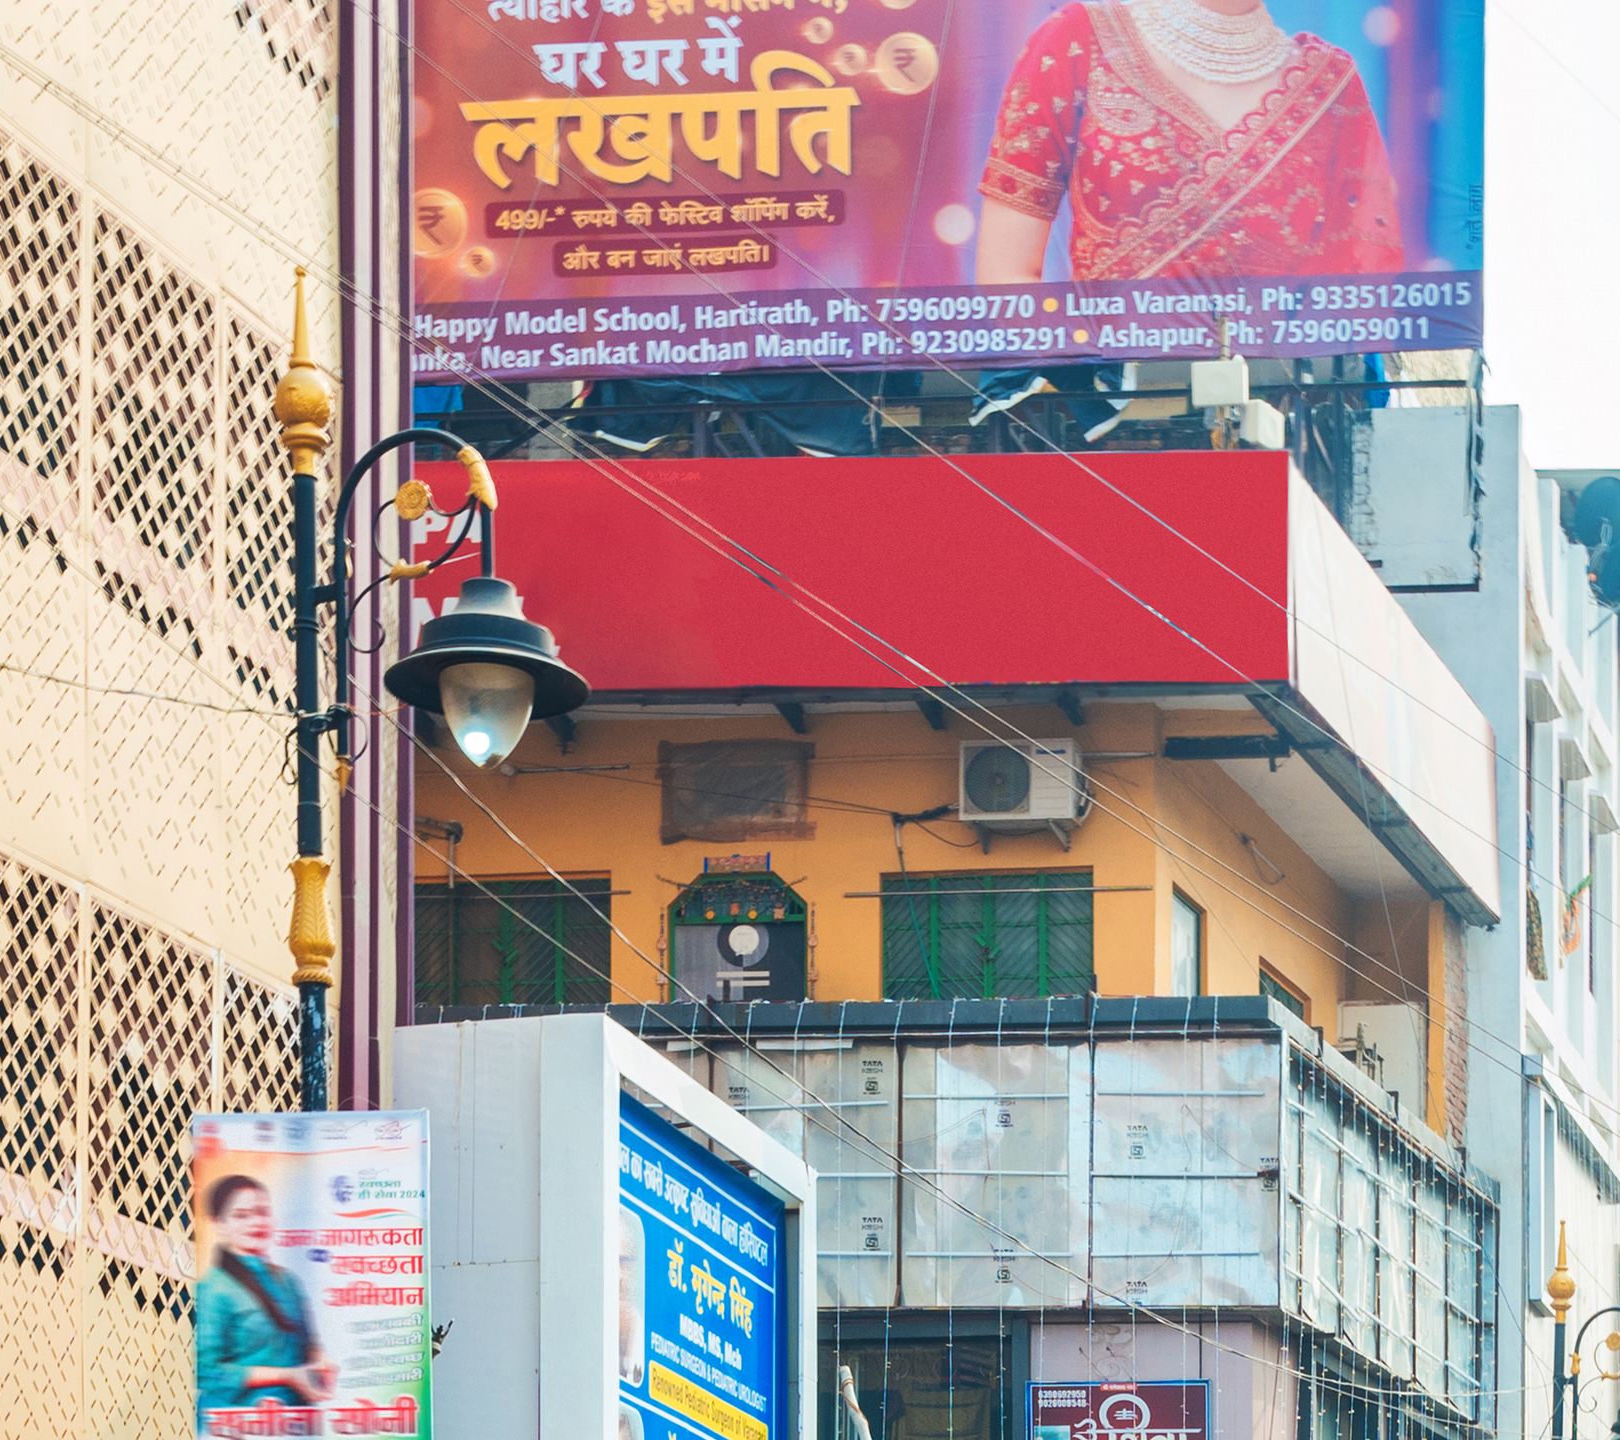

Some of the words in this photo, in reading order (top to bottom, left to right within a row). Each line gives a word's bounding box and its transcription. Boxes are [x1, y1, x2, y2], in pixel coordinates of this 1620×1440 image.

[533, 39, 606, 88] घर
[615, 39, 689, 86] घर
[696, 16, 743, 83] में
[460, 50, 861, 190] लखपति
[571, 202, 617, 229] रुपये
[625, 200, 652, 228] की
[659, 200, 723, 226] फेस्टिव
[730, 194, 789, 224] शॉपिंग
[562, 244, 598, 271] और
[606, 252, 636, 270] बन
[414, 312, 496, 342] Happy
[505, 308, 587, 335] Model
[594, 304, 687, 334] School,
[827, 297, 869, 323] Ph:
[876, 294, 1035, 322] 7596099770
[1065, 291, 1126, 318] Luxa
[1132, 288, 1253, 316] Varanasi,
[1261, 286, 1303, 311] Ph:
[1311, 281, 1472, 309] 9335126015
[483, 346, 542, 370] Near
[549, 343, 639, 367] Sankat
[646, 338, 746, 365] Mochan
[755, 332, 852, 360] Mandir,
[862, 330, 903, 355] Ph:
[911, 326, 1067, 355] 9230985291
[1098, 322, 1215, 350] Ashapur,
[1224, 320, 1264, 346] Ph:
[1271, 317, 1430, 345] 7596059011
[400, 1190, 425, 1199] 2024
[667, 1237, 687, 1293] डॉ.
[729, 1276, 755, 1339] सिंह
[680, 1314, 707, 1354] MBBS,
[725, 1342, 743, 1370] Mch
